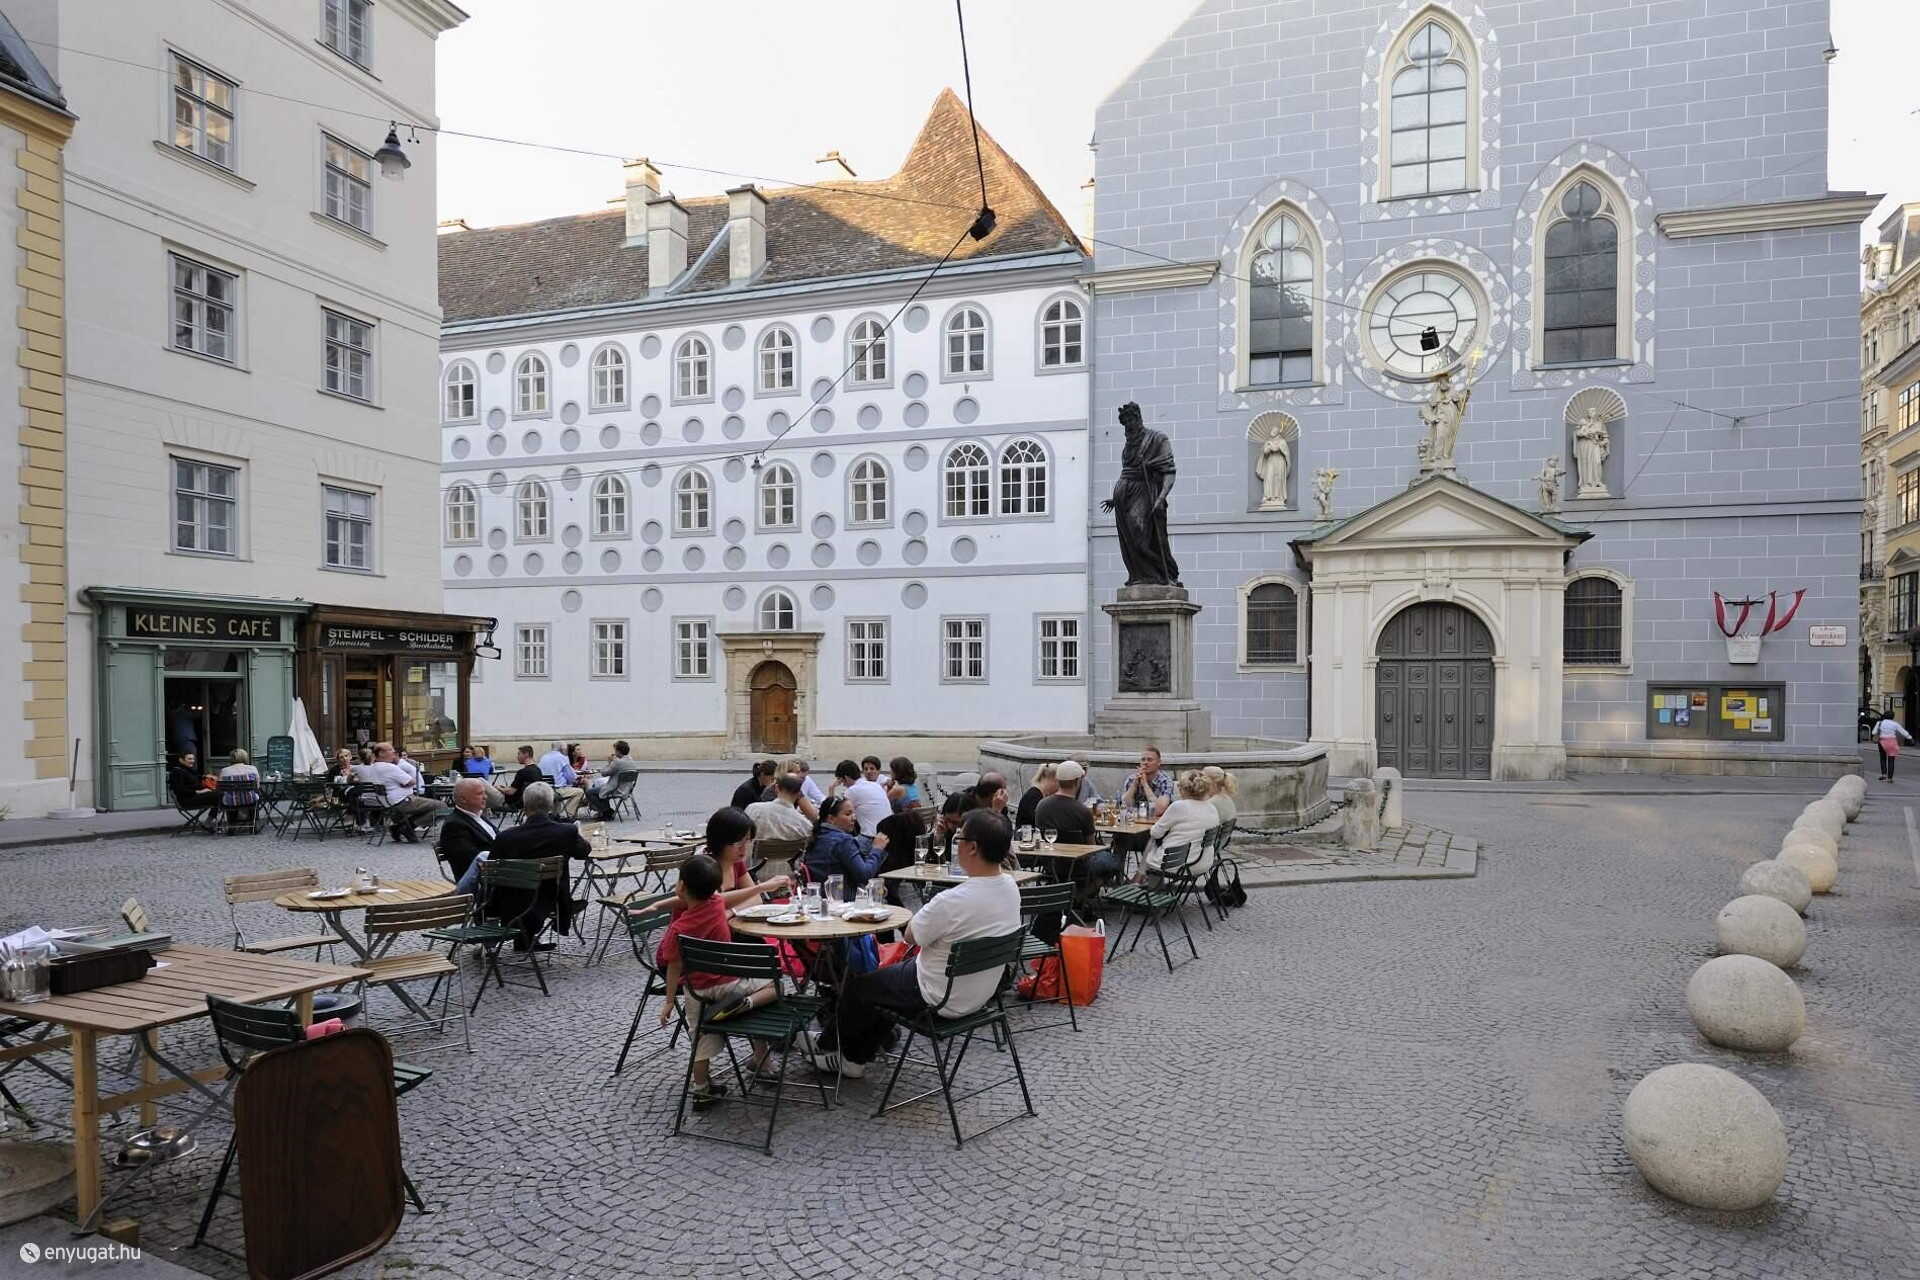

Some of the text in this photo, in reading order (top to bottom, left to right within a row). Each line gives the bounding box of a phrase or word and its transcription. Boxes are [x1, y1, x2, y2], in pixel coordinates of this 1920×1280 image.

[135, 614, 272, 637] KLEINES CAFÉ
[328, 629, 385, 640] STEMPEL
[400, 632, 454, 643] SCHILDER
